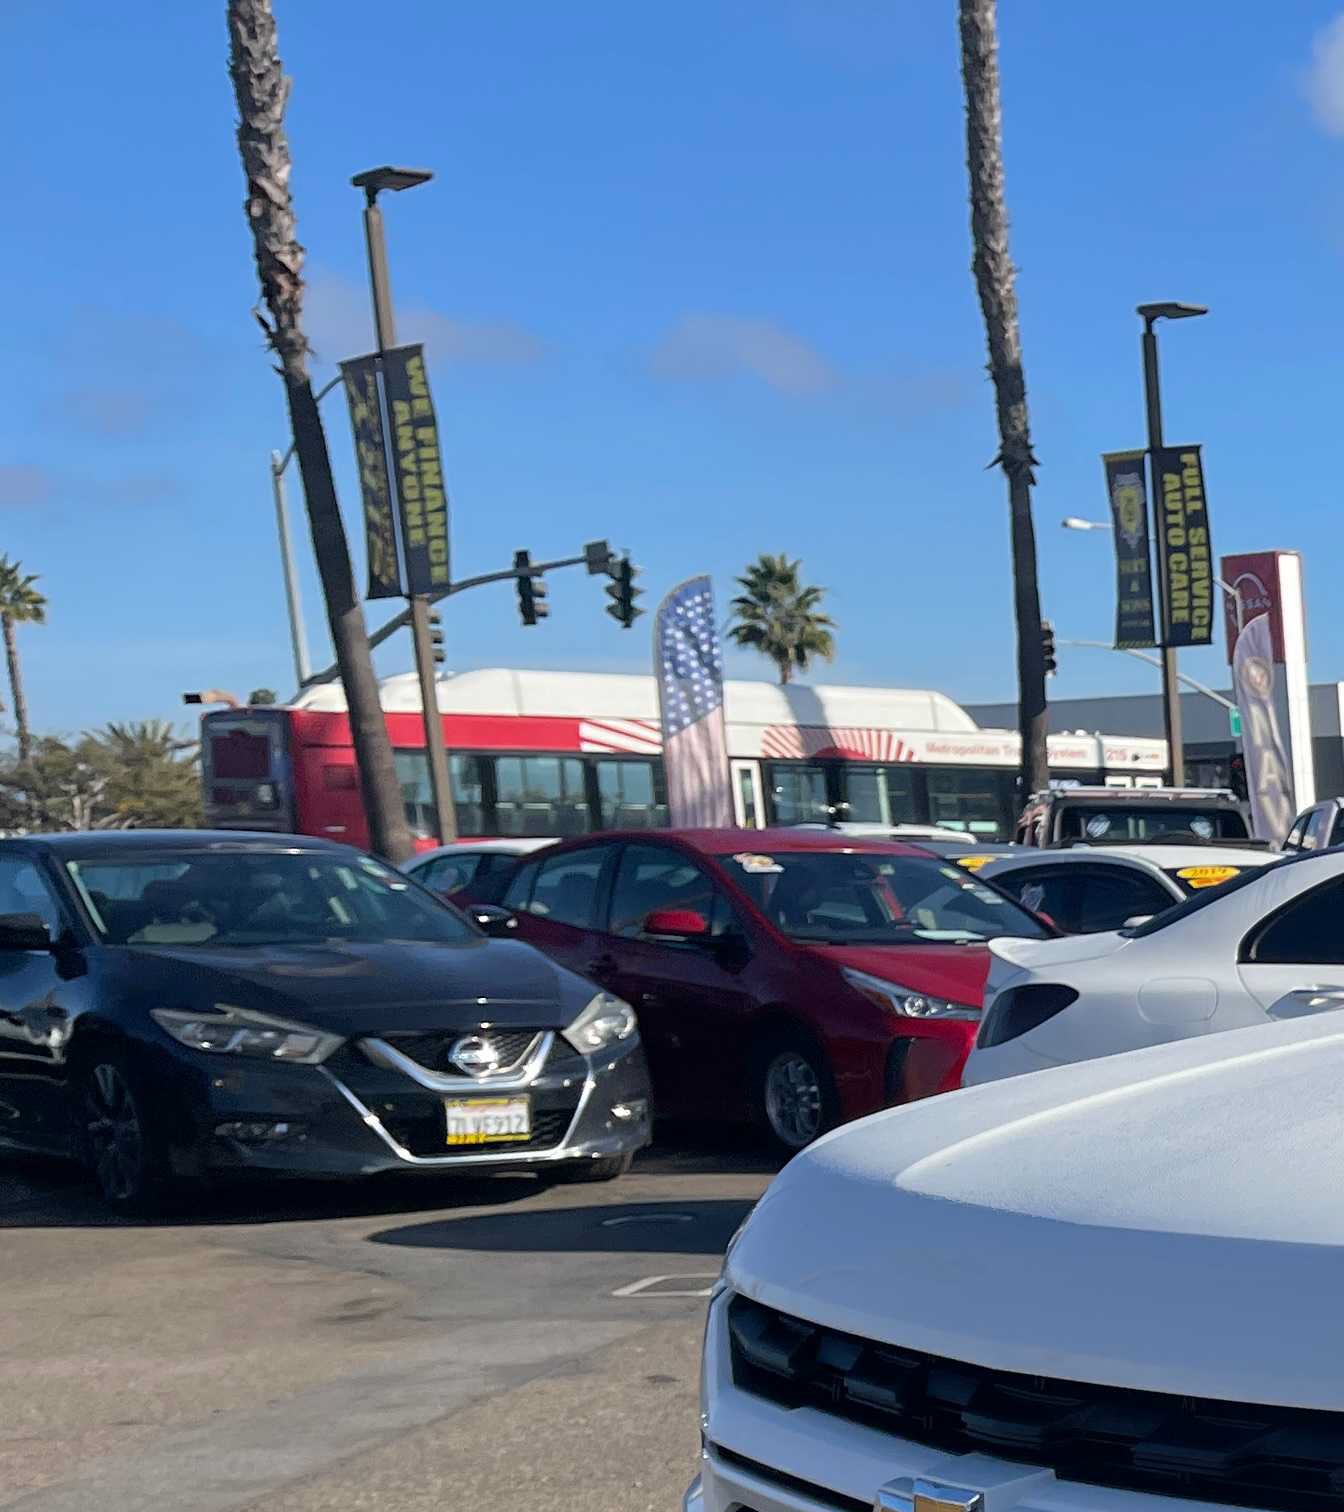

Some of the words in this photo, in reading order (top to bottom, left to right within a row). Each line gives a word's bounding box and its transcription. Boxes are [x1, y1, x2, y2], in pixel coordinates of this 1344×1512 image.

[405, 354, 433, 417] WE
[392, 400, 427, 547] ANYONE
[415, 425, 449, 585] FINANCE
[1162, 472, 1186, 547] AUTO
[1179, 453, 1204, 516] FULL
[1168, 553, 1190, 625] CARE
[1187, 526, 1210, 641] SERVICE
